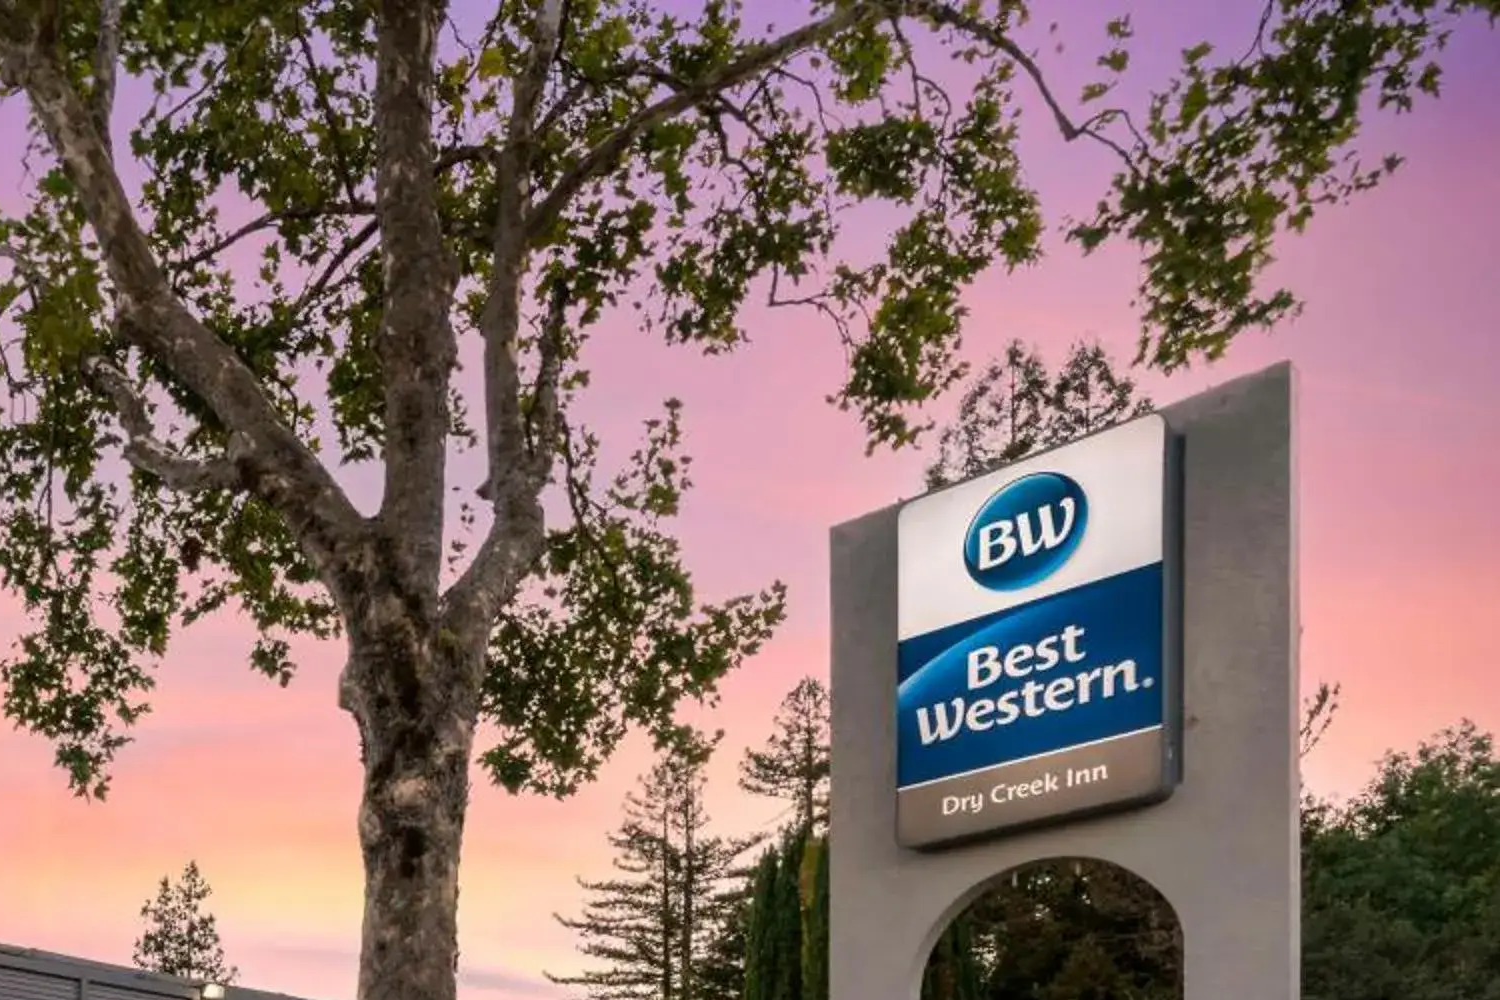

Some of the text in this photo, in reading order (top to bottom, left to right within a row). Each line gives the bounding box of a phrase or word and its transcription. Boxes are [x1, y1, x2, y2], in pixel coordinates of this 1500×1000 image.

[978, 497, 1075, 571] BW
[966, 624, 1085, 690] Best
[941, 764, 1108, 815] Dry Creek Inn
